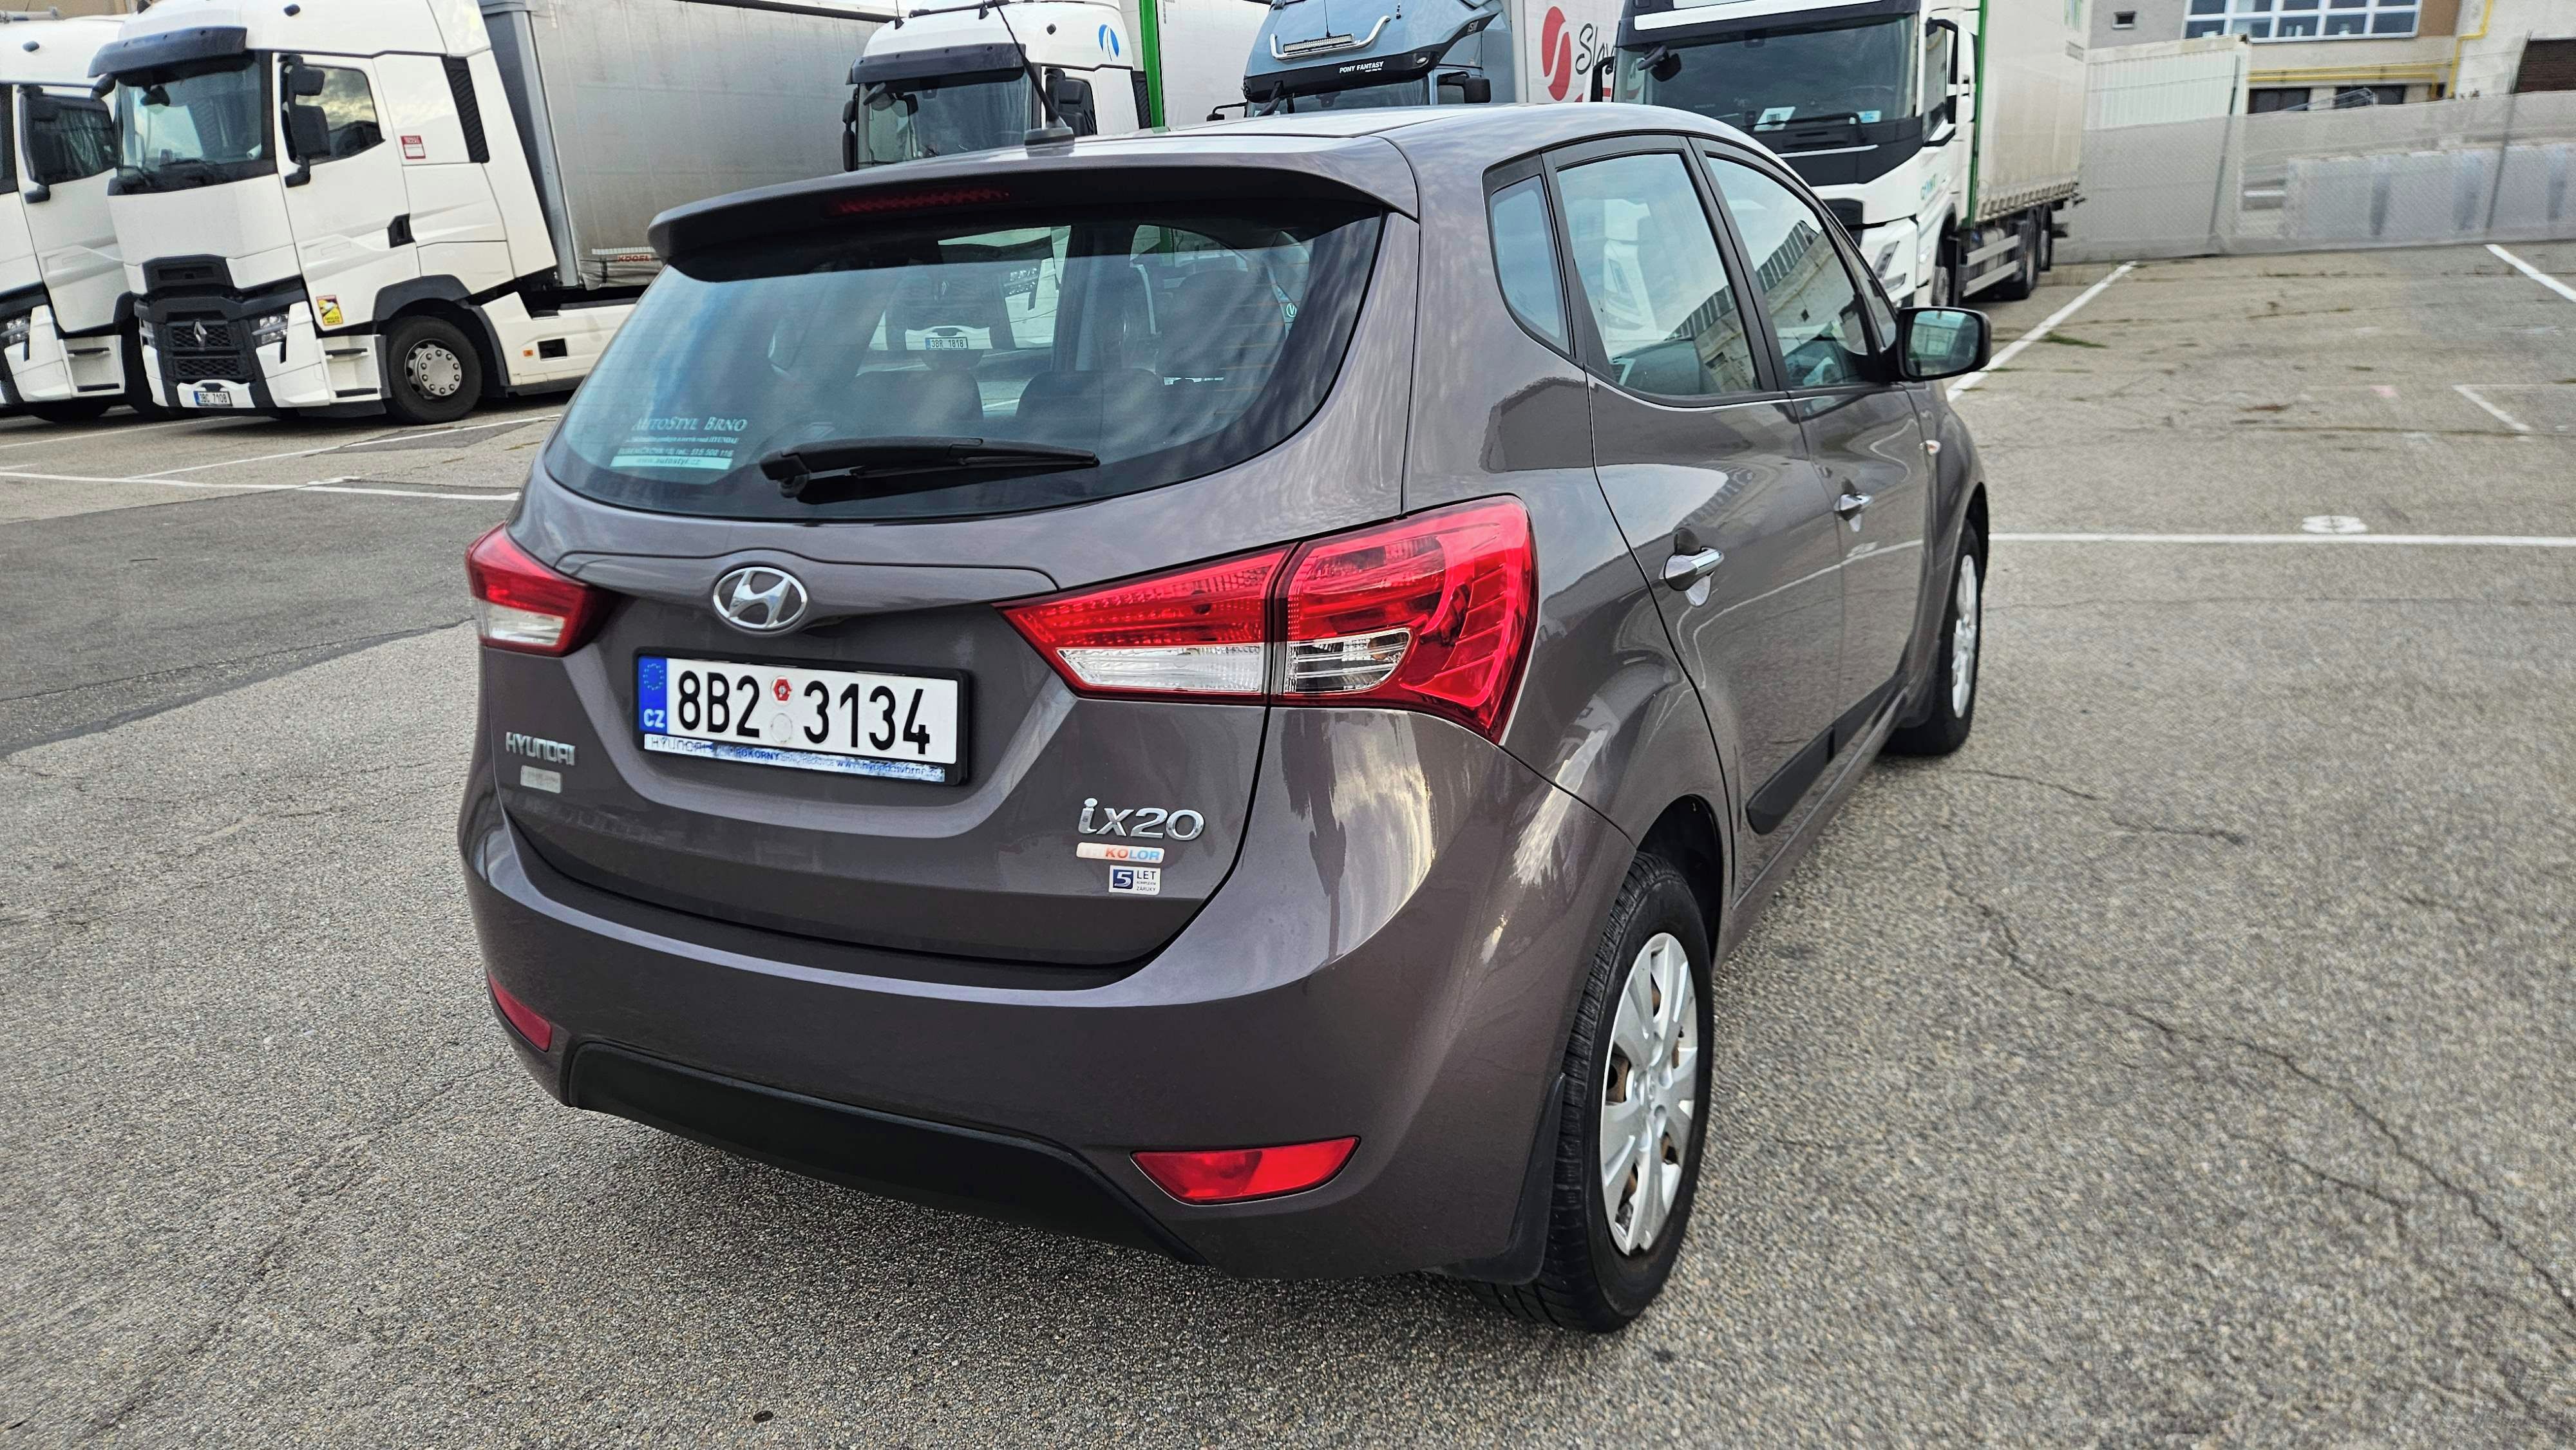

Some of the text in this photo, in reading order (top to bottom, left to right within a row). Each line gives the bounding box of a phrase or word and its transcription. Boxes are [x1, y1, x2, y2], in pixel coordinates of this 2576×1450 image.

[1356, 61, 1384, 70] FANTASY
[931, 339, 963, 348] 3BR 1818
[644, 709, 665, 728] CZ
[678, 670, 930, 755] 8B2 3134
[506, 731, 576, 766] HYUNDAI
[1078, 798, 1204, 841] ix20
[1114, 871, 1157, 887] 5 LET
